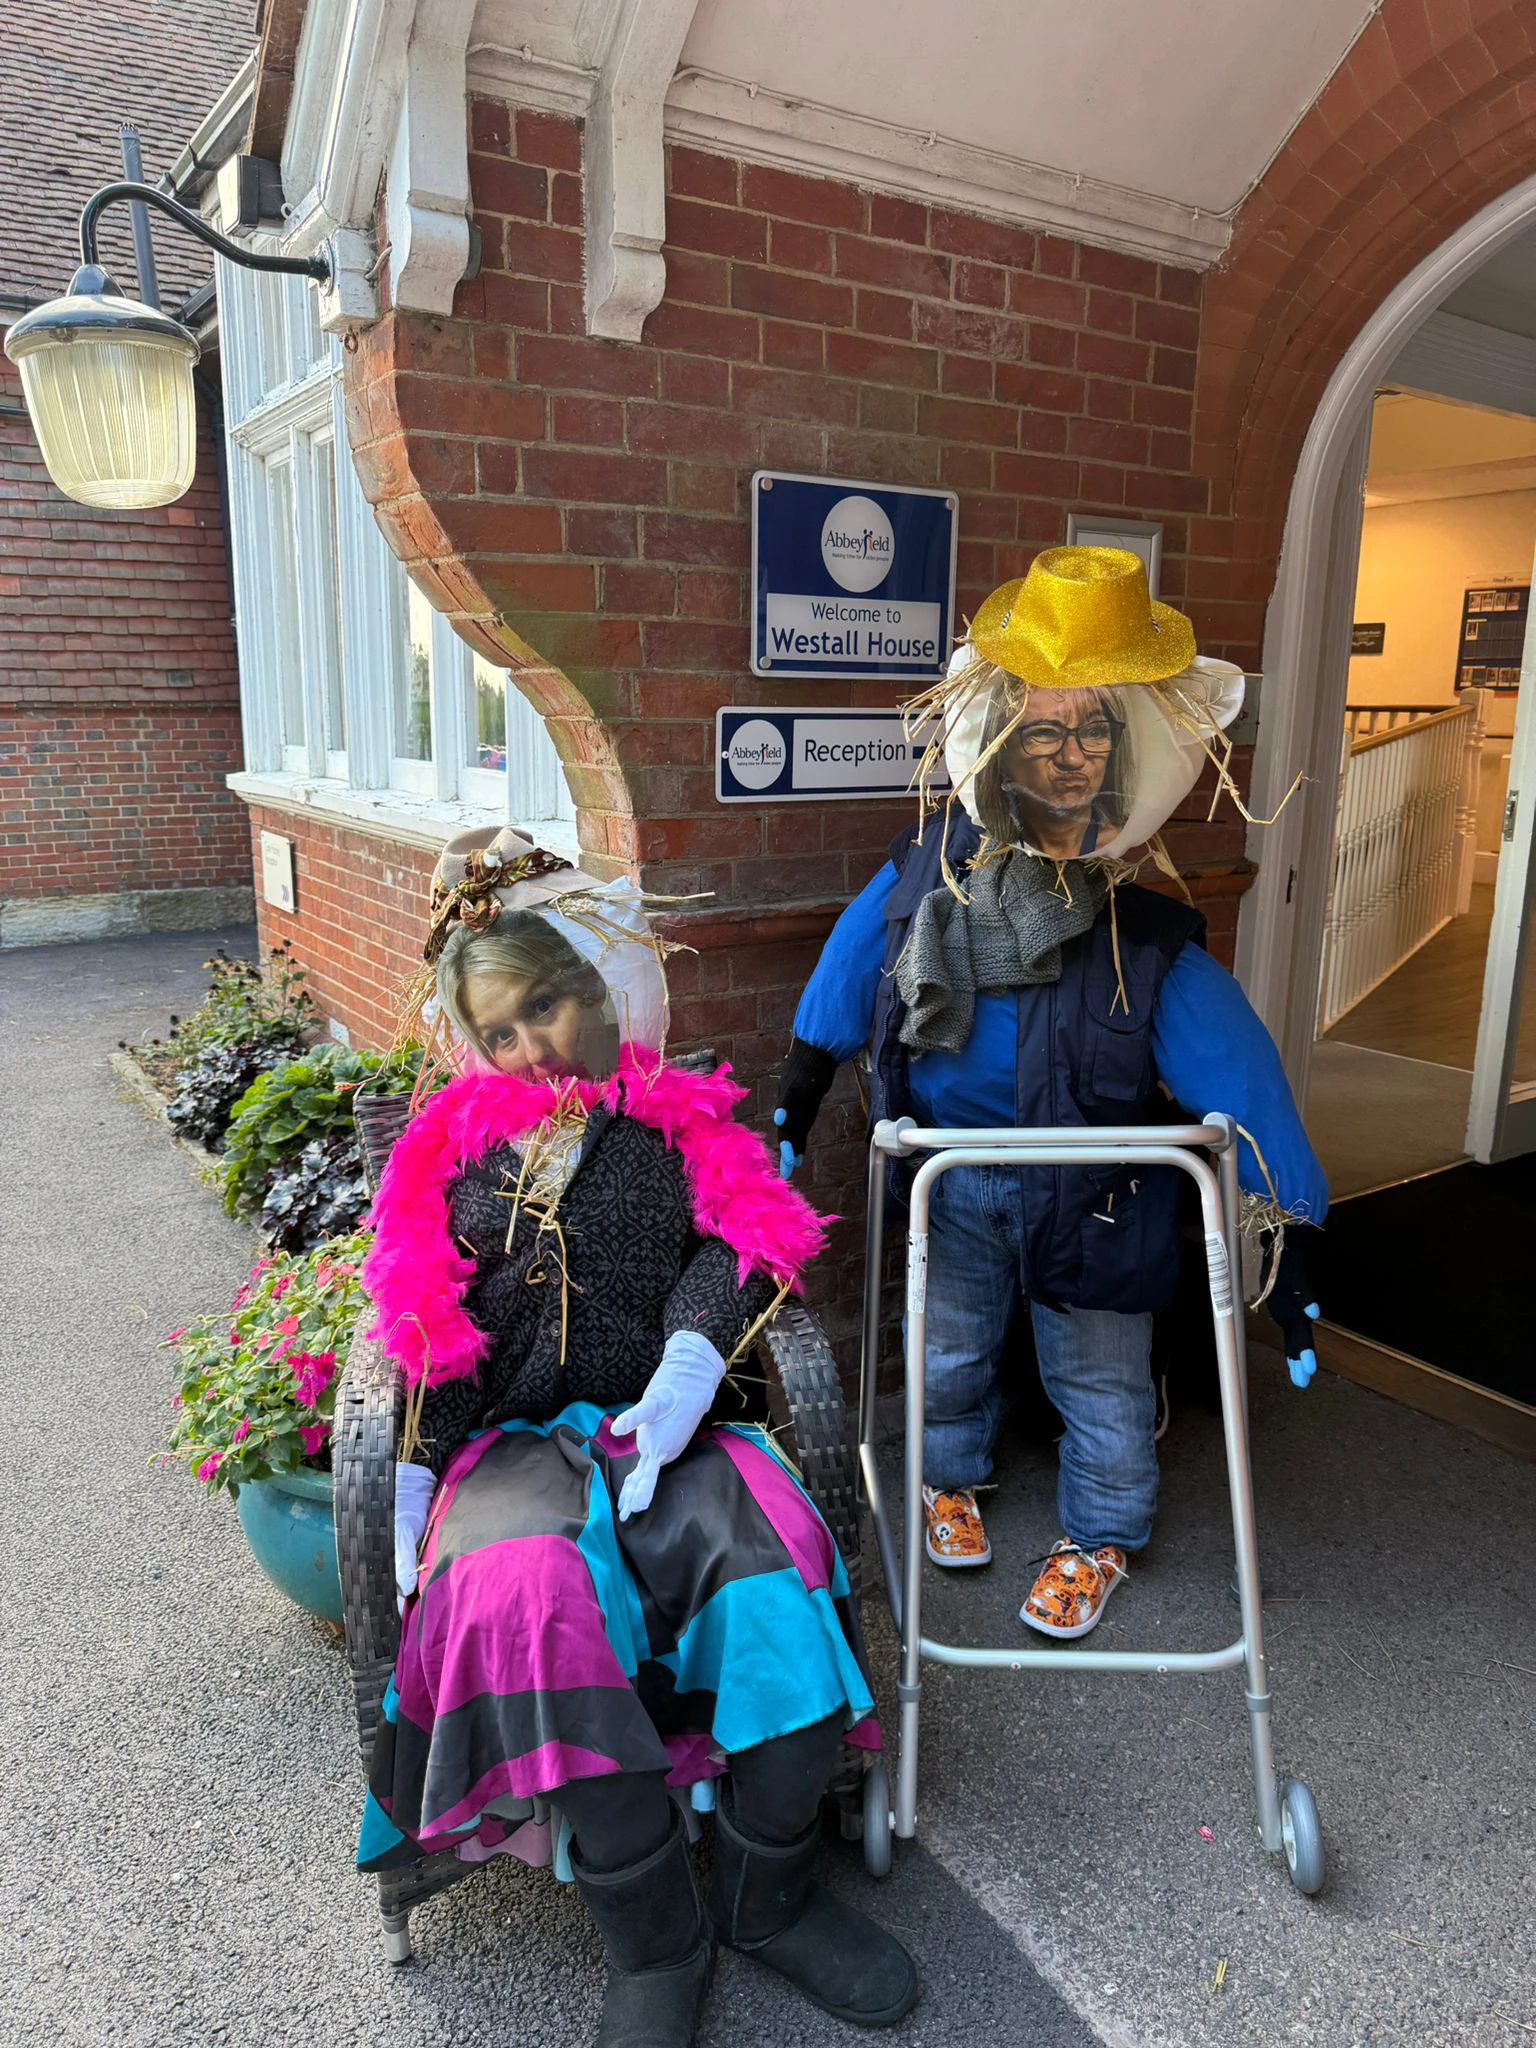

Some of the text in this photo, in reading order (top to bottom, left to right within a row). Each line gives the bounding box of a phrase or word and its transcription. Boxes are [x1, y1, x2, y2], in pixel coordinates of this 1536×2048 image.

[825, 528, 889, 559] Abbeyfield
[811, 602, 901, 623] Welcome to
[771, 627, 935, 658] Westall House
[731, 743, 782, 765] Abbeyfield
[804, 739, 907, 767] Reception
